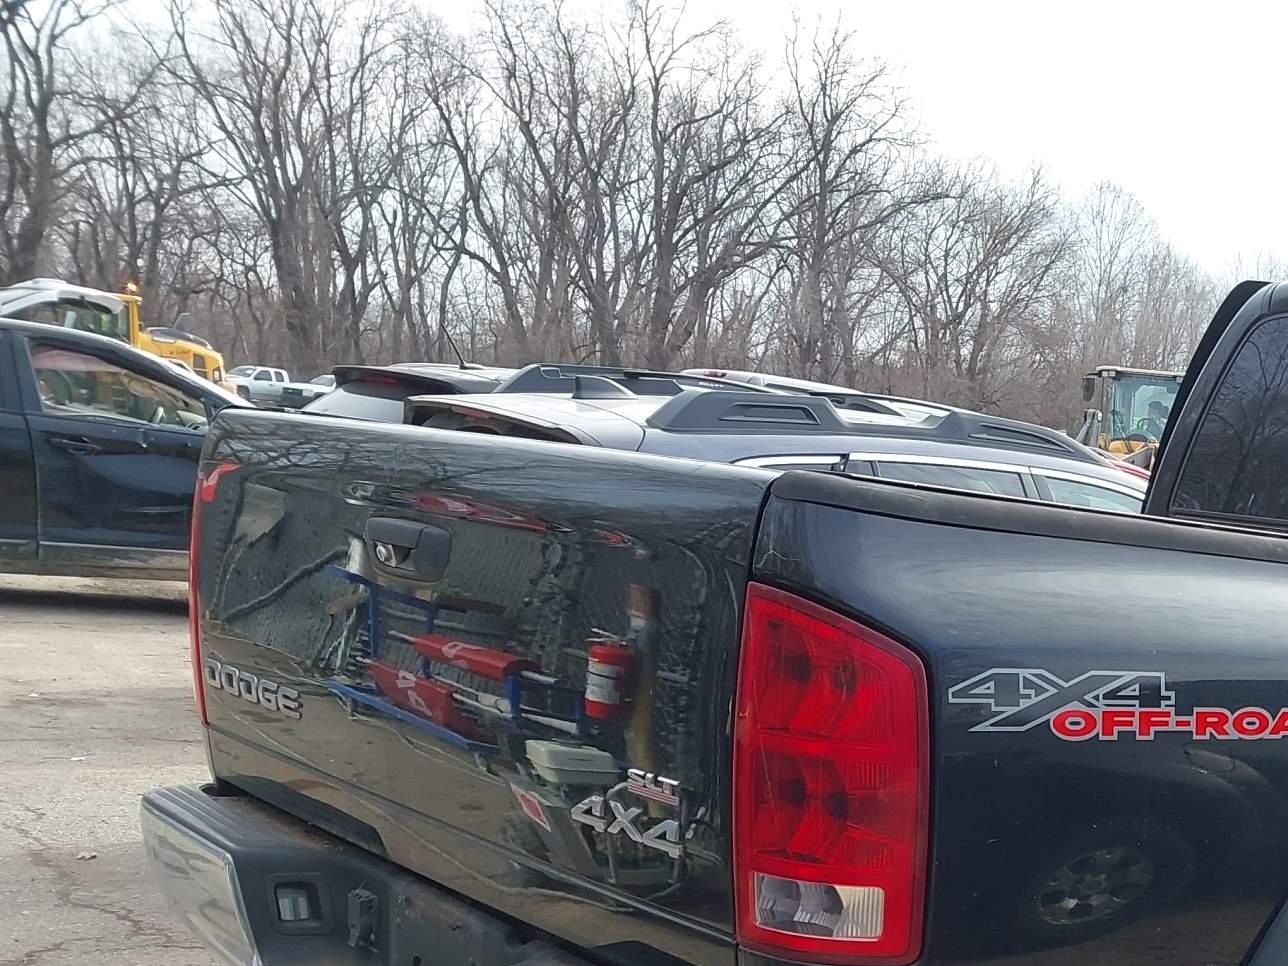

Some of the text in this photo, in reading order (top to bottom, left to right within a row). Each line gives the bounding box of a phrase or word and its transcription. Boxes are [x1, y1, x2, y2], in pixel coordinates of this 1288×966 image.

[206, 657, 303, 720] DODGE
[948, 668, 1175, 731] 4X4
[627, 768, 681, 797] SLT
[571, 795, 684, 859] 4X4
